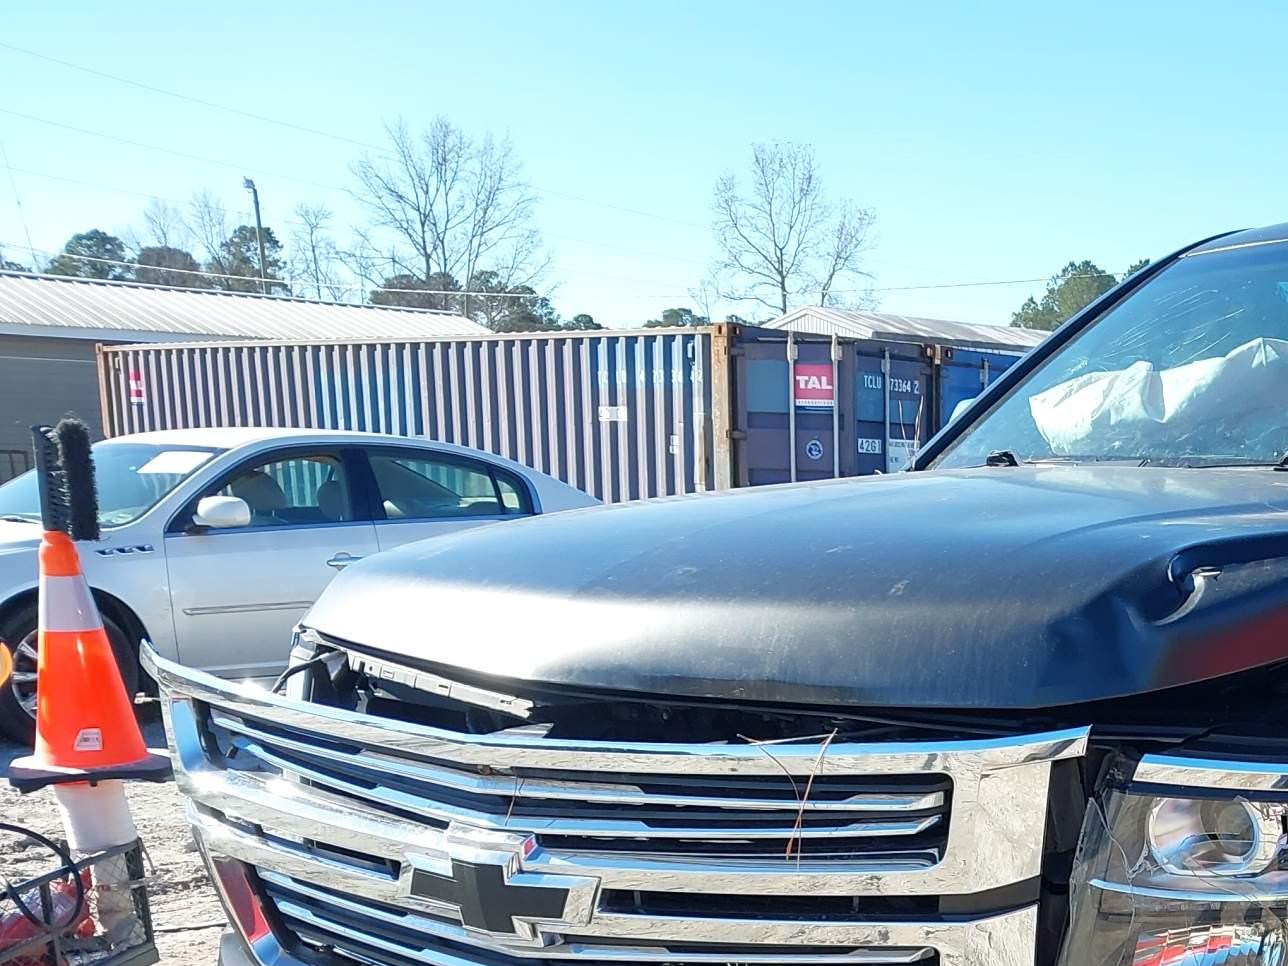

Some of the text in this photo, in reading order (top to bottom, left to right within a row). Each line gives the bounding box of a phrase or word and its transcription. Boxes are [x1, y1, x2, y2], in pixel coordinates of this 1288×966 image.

[795, 375, 833, 390] TAL
[863, 375, 882, 389] TCLU
[889, 378, 911, 393] 73364
